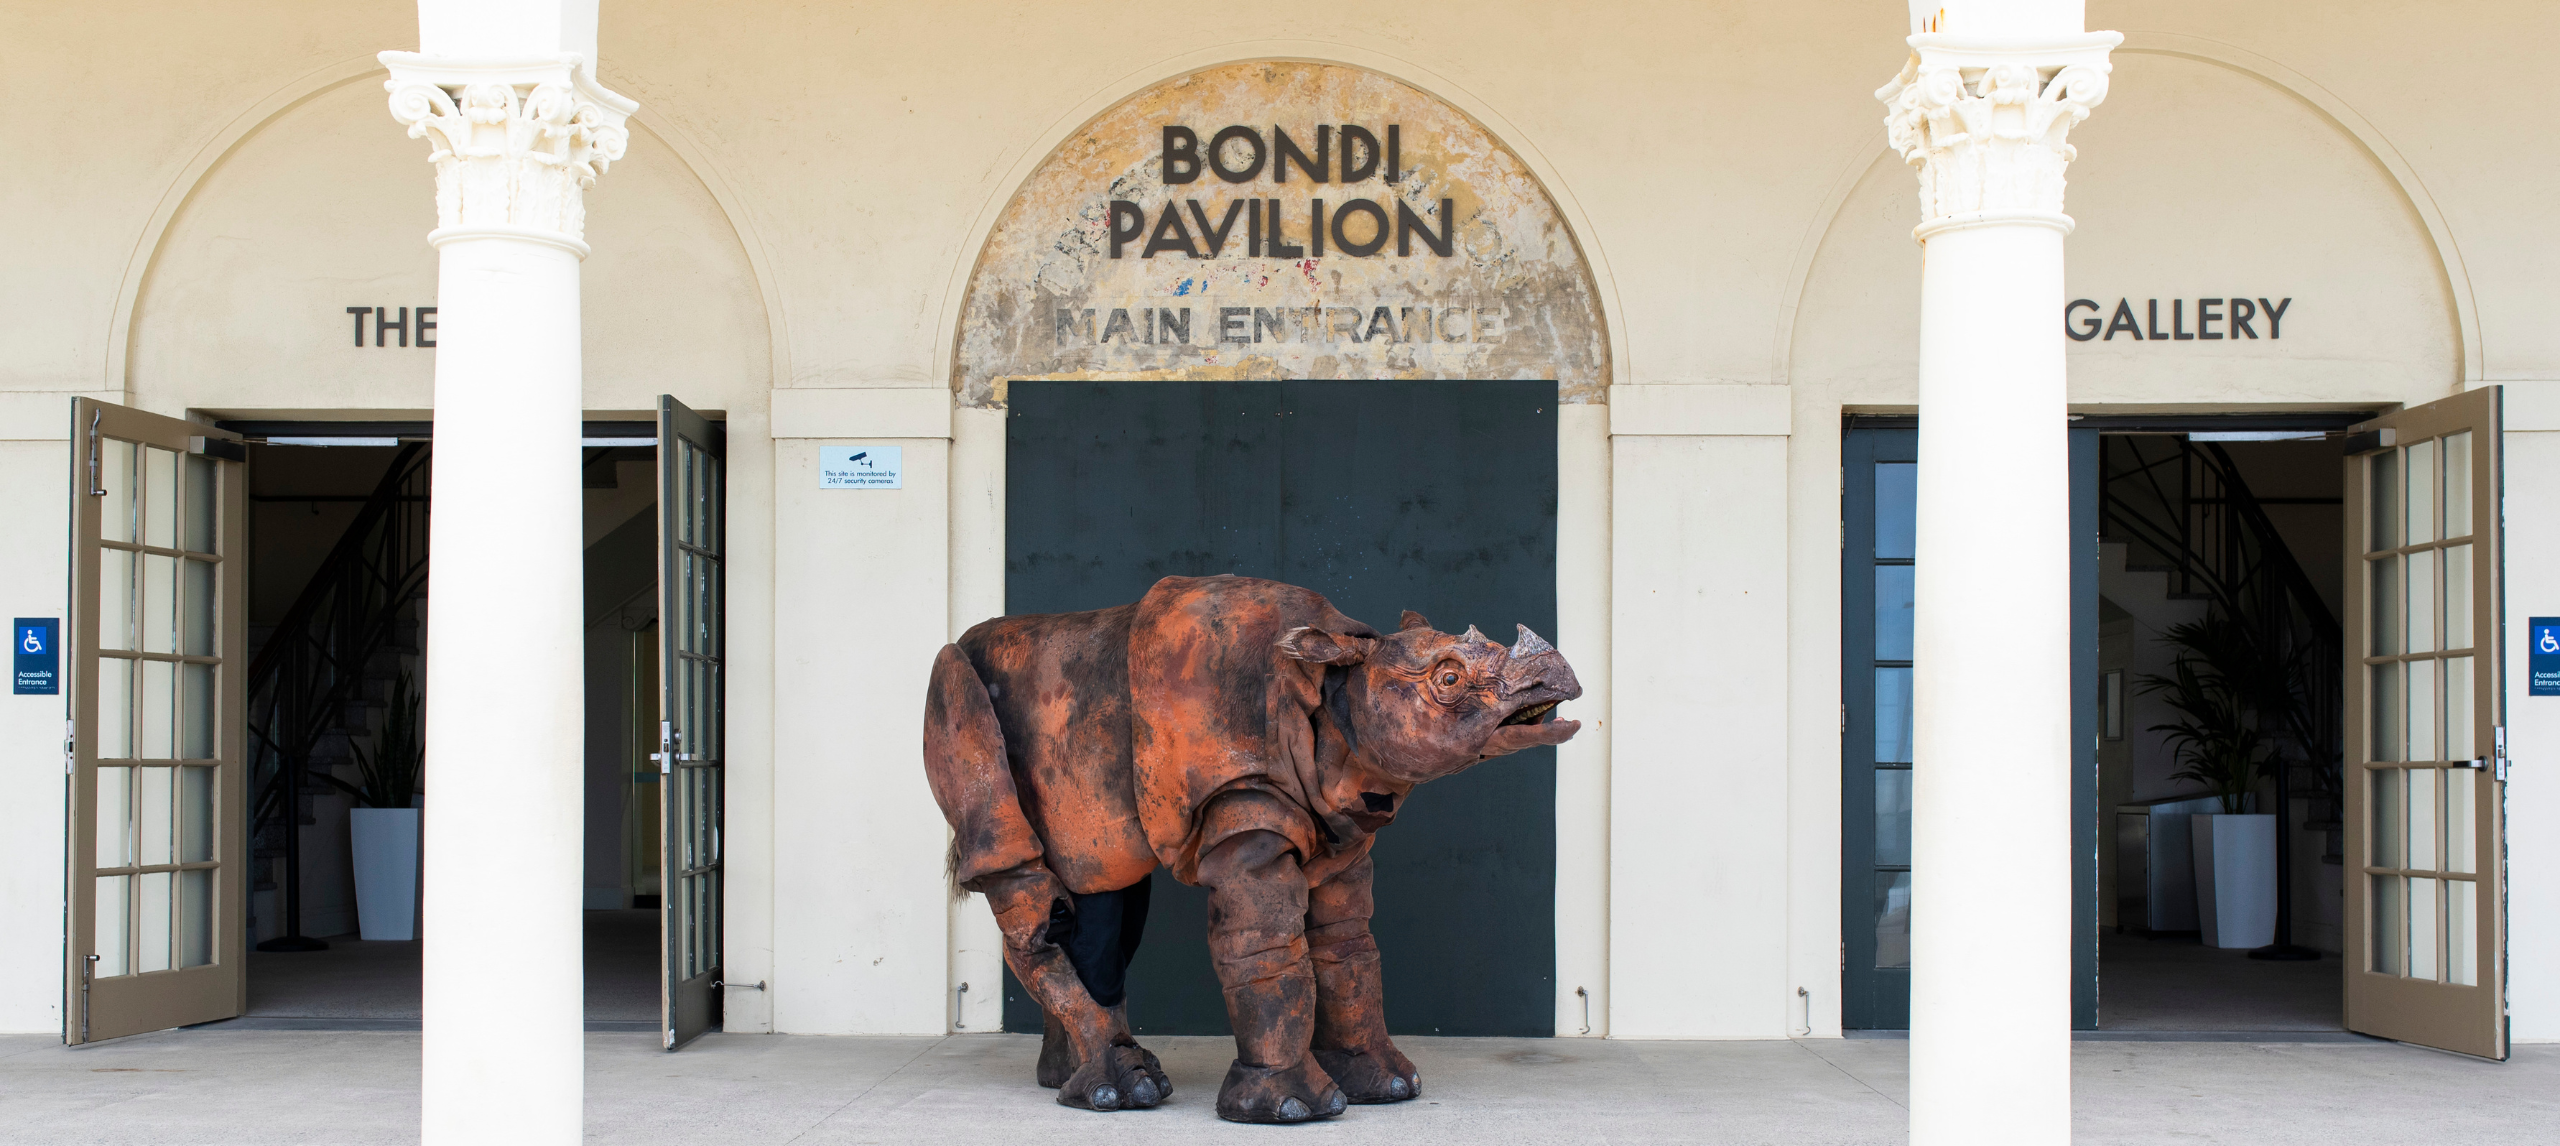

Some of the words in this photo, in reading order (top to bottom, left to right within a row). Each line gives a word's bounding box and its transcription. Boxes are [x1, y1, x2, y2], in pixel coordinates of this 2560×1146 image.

[1163, 123, 1400, 184] BONDI
[1110, 198, 1453, 259] PAVILION
[346, 307, 437, 347] THE
[1056, 307, 1191, 346] MAIN
[1219, 306, 1503, 343] ENTRANCE
[2065, 297, 2292, 342] GALLERY
